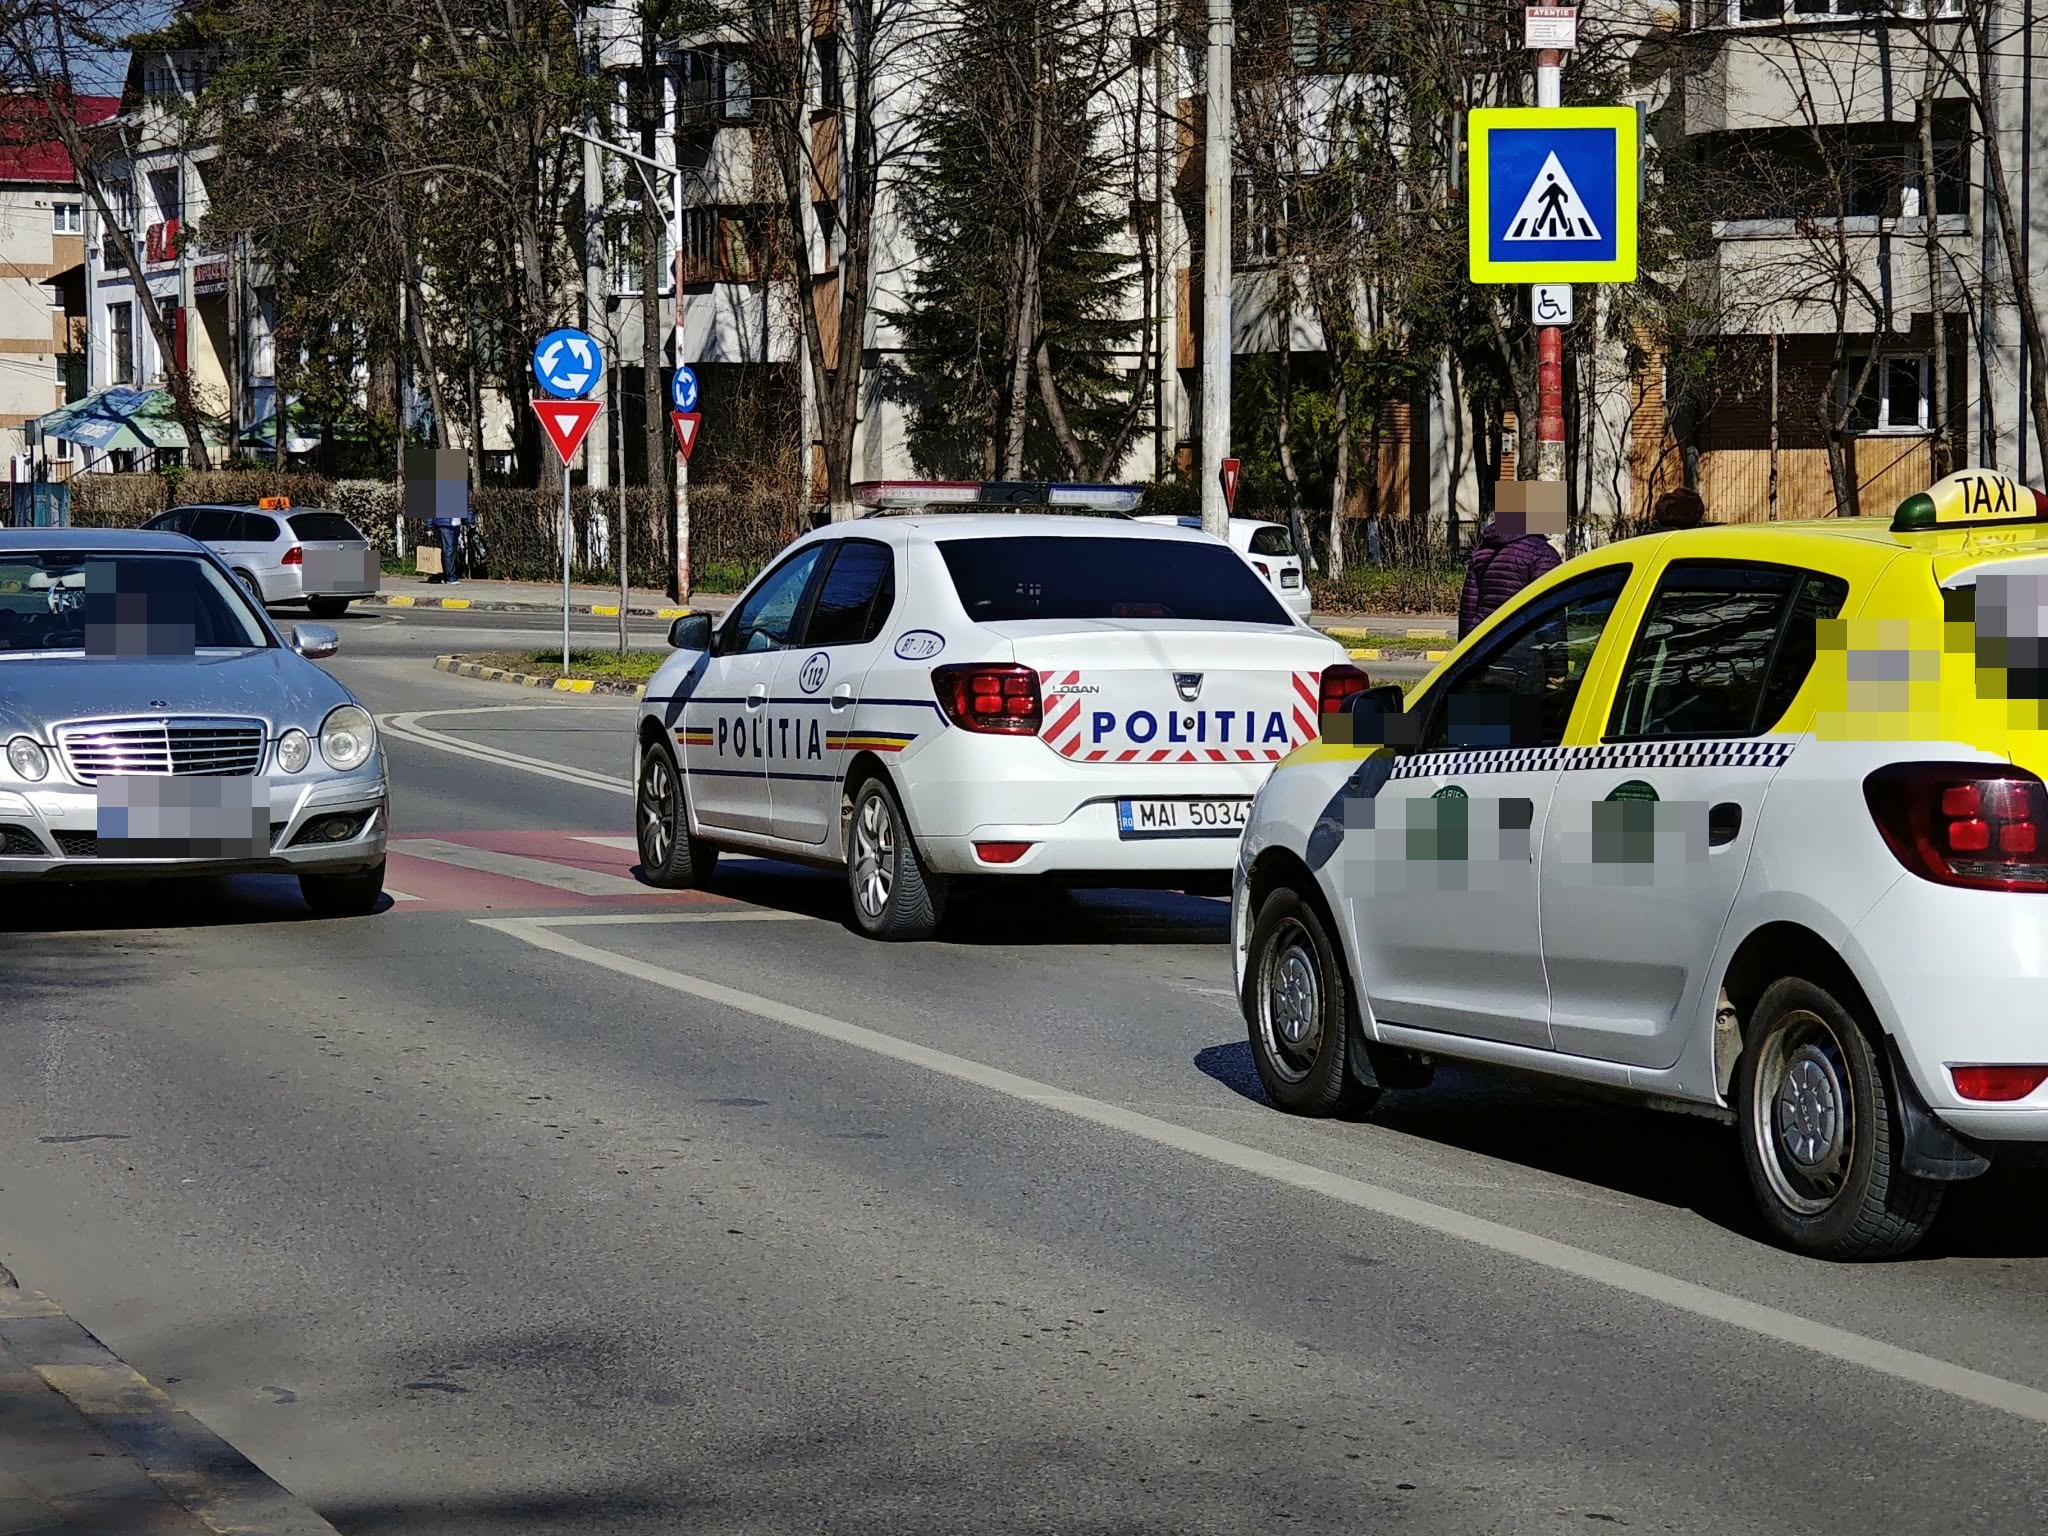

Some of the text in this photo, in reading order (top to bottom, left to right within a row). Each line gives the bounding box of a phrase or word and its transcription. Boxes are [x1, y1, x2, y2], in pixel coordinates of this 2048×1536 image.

[1954, 475, 2017, 515] TAXI
[807, 667, 824, 687] 112
[1052, 685, 1100, 694] LOGAN
[718, 716, 822, 760] POLITIA
[1092, 709, 1289, 744] POLITIA
[1122, 818, 1133, 828] RO
[1139, 803, 1252, 827] MAI 5034
